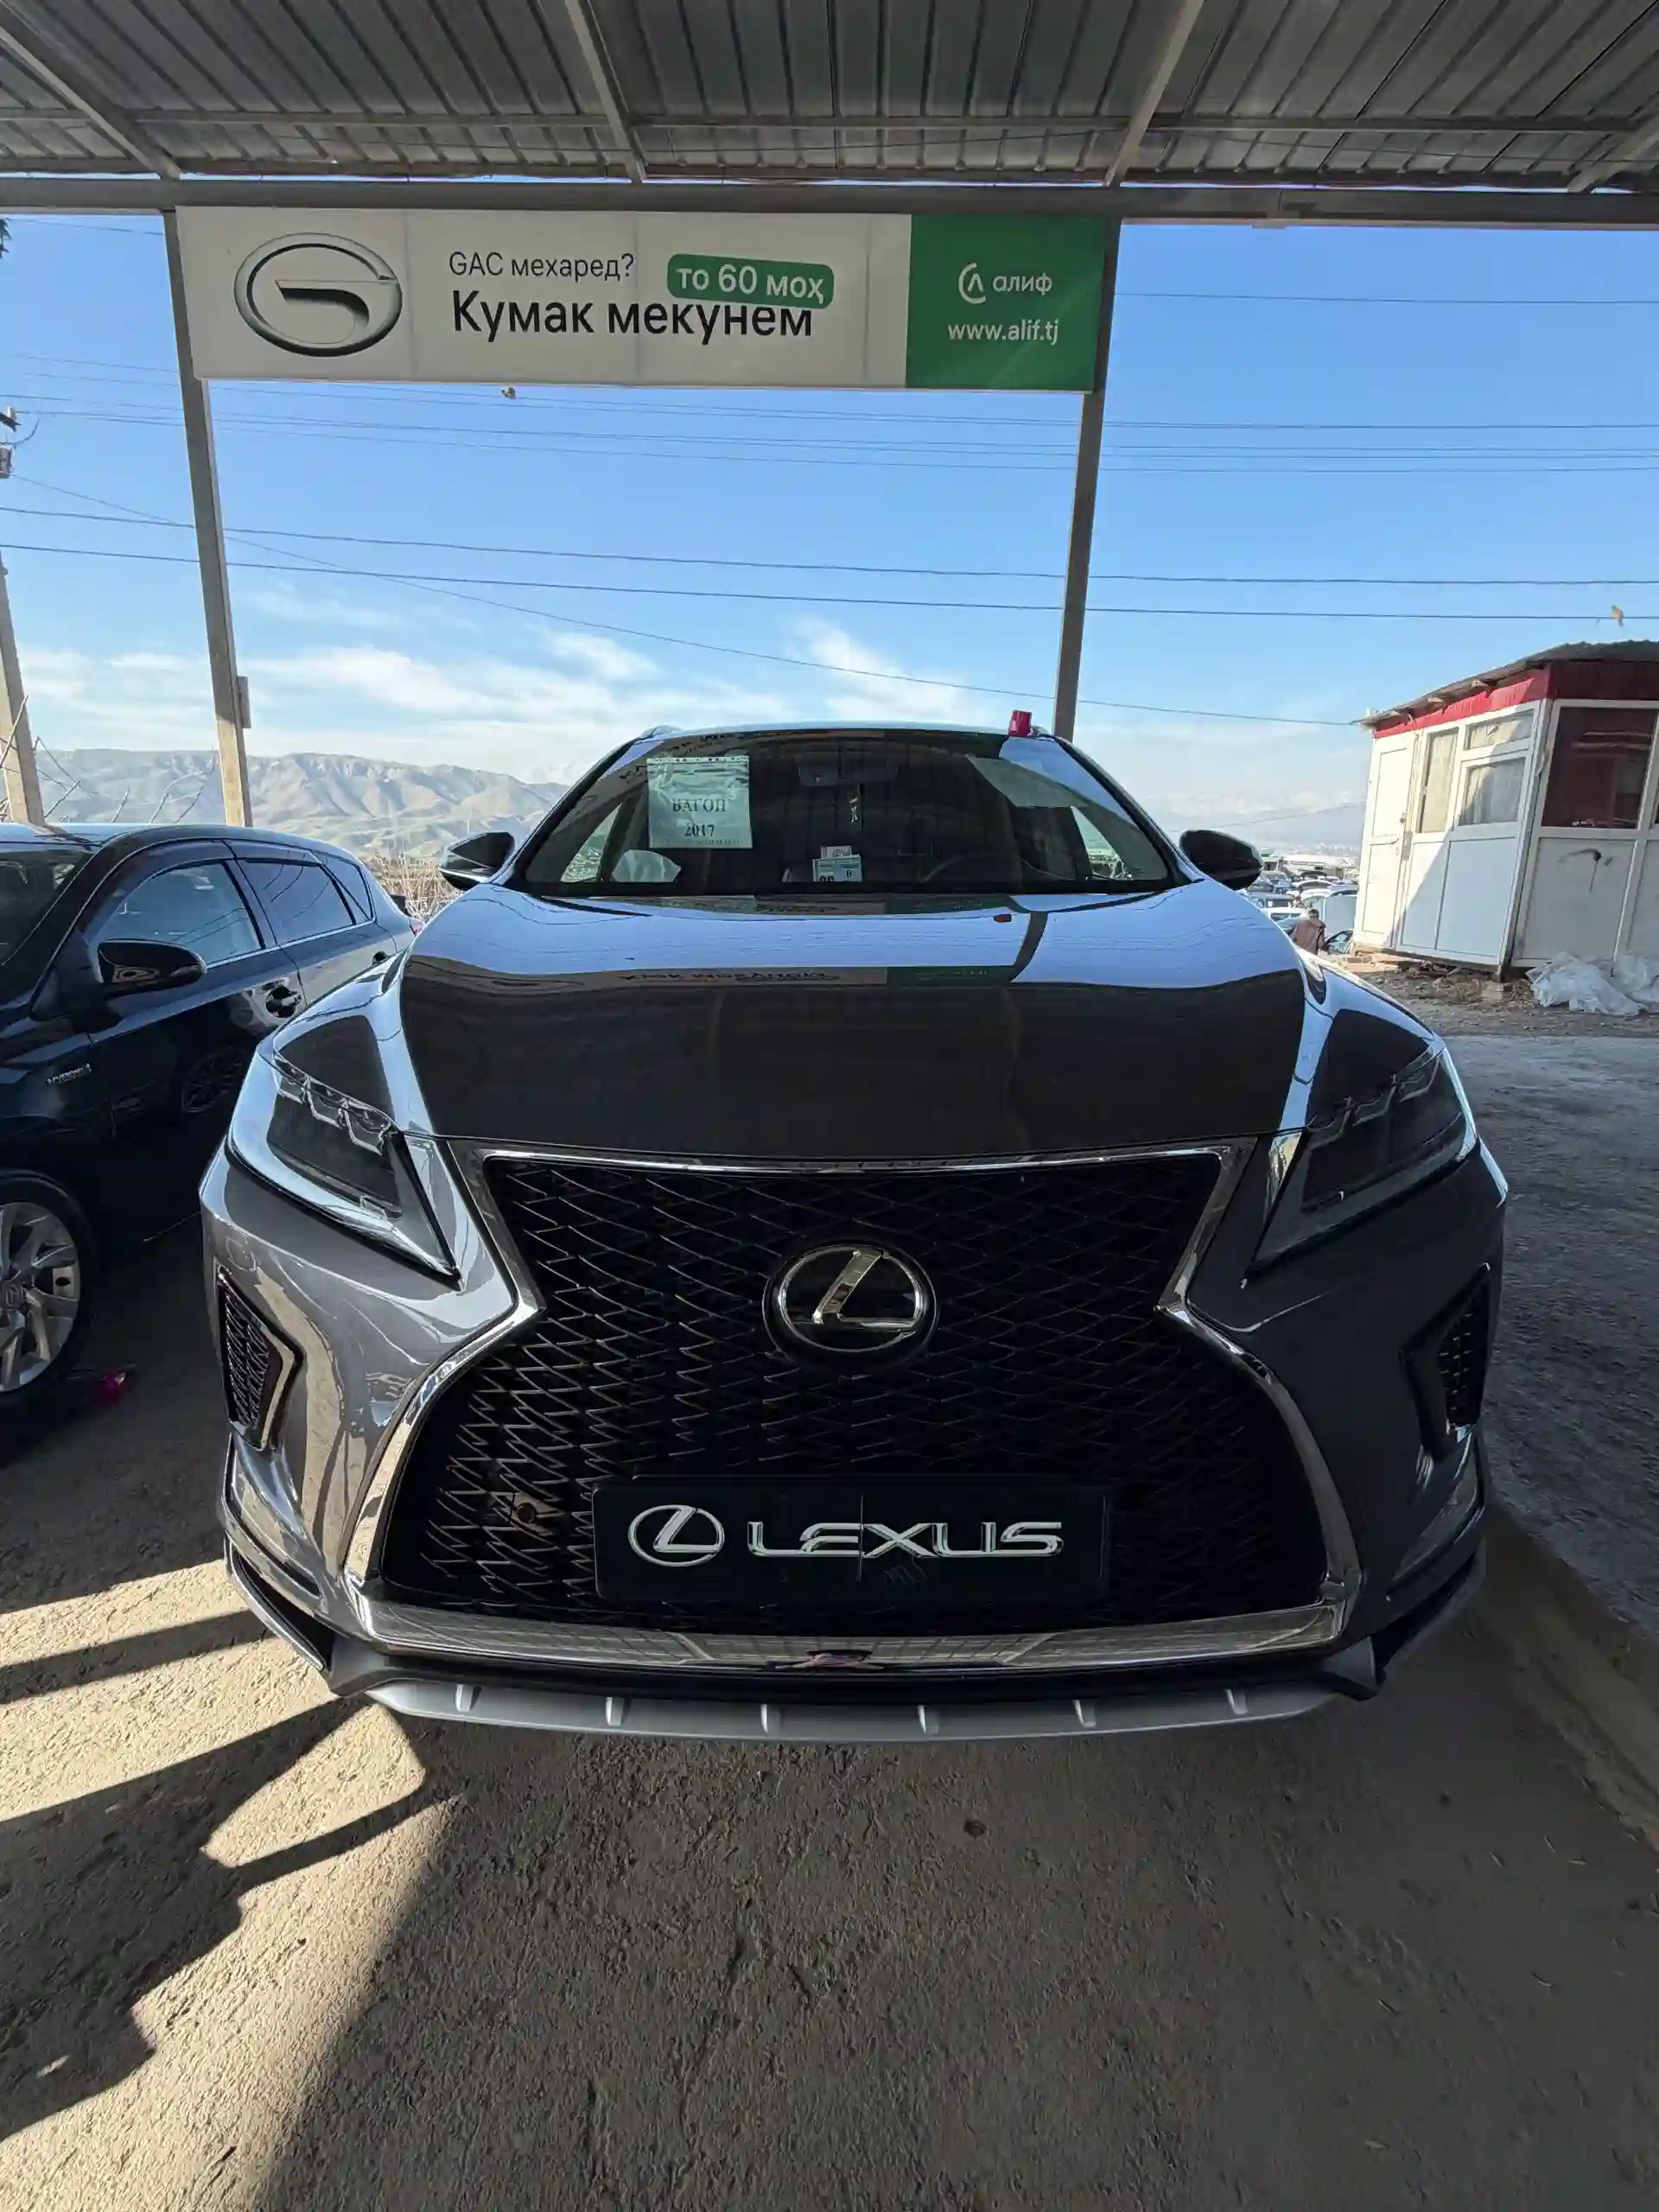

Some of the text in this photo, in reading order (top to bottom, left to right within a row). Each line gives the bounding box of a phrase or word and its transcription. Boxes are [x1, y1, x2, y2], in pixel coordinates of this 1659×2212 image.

[448, 251, 634, 283] GAC мехаред?
[676, 267, 710, 291] то
[717, 263, 758, 295] 60
[993, 272, 1053, 296] алиф
[452, 289, 812, 346] Кумак мекунем
[947, 317, 1059, 346] www.alif.tj
[684, 823, 715, 837] 2017
[747, 1521, 1064, 1559] LEXUS
